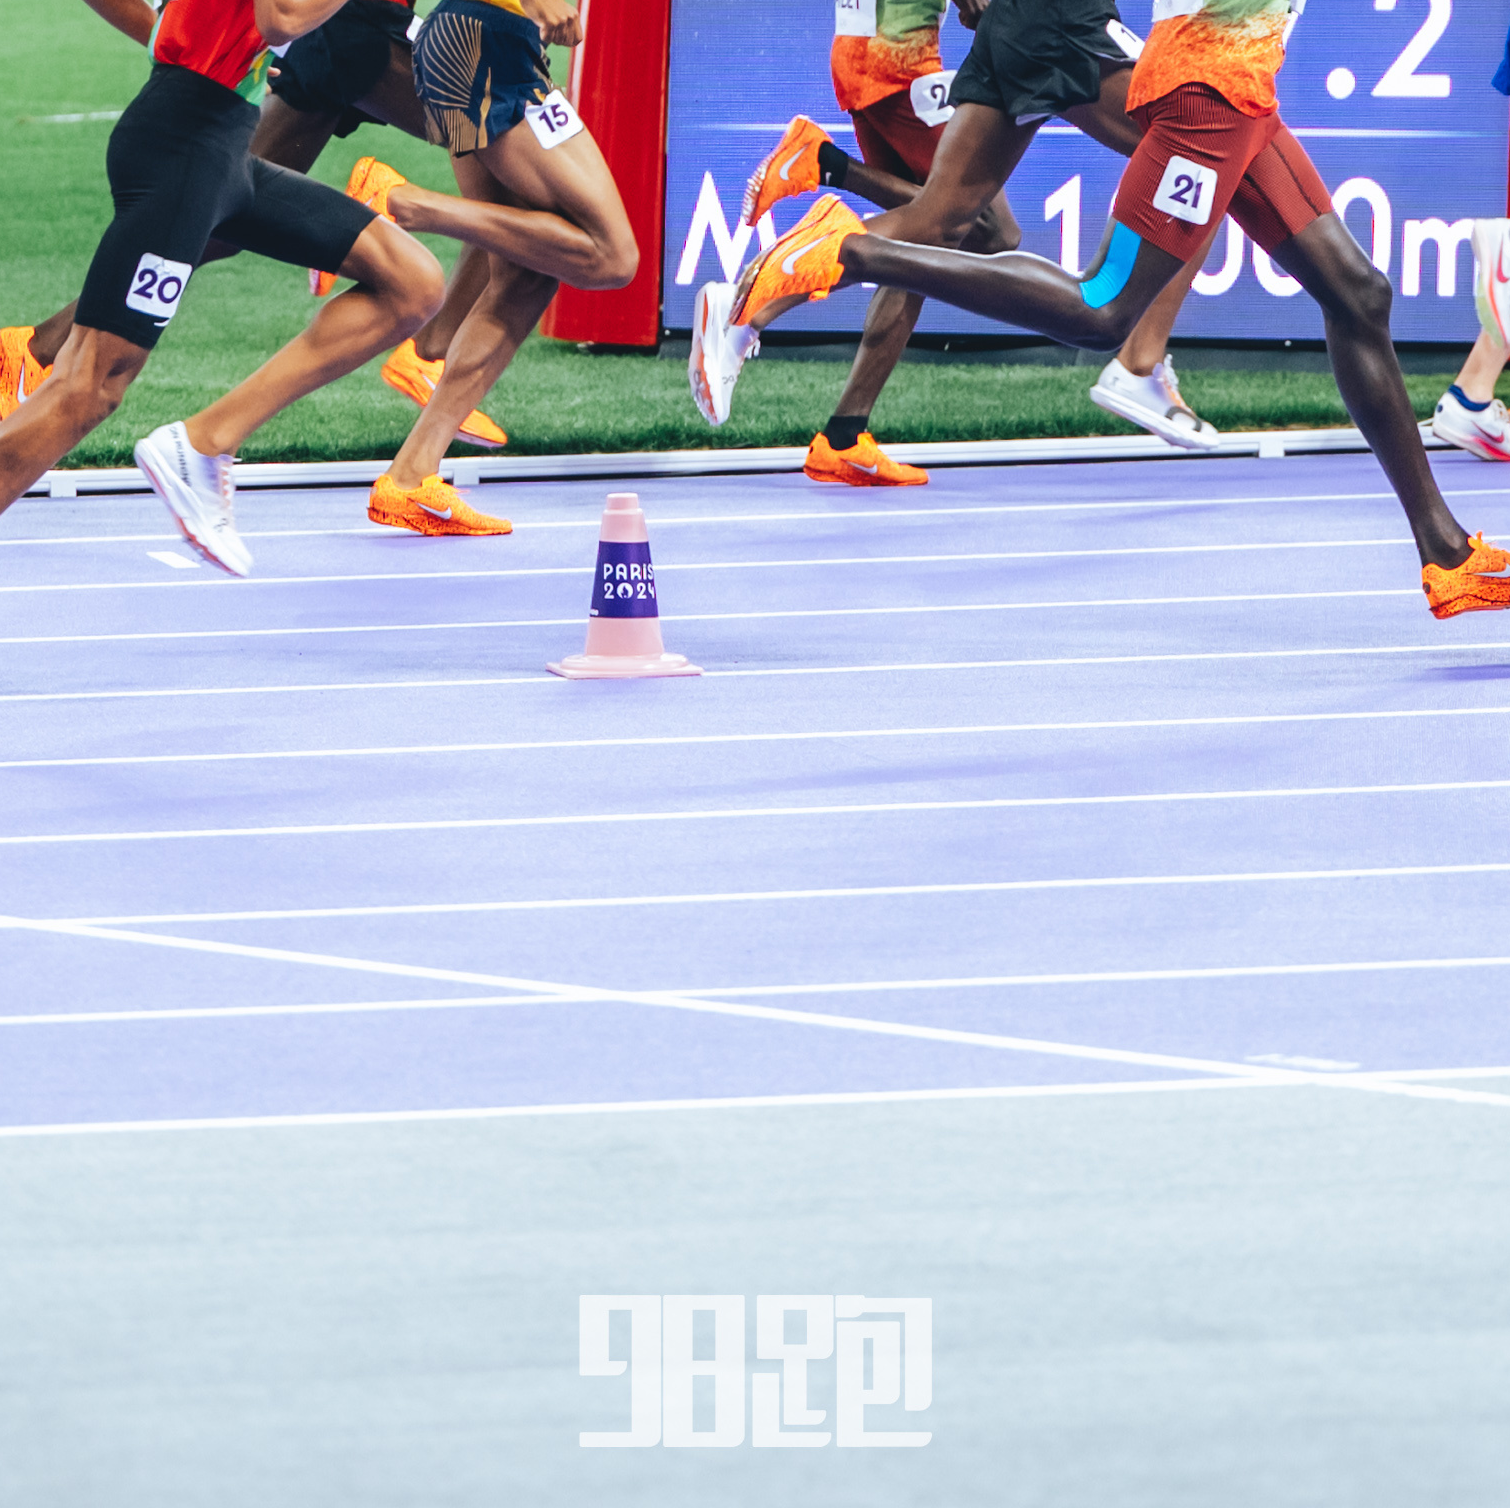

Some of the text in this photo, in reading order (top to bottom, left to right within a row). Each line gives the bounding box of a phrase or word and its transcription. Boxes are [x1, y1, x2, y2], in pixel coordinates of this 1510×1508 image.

[538, 103, 570, 133] 15
[1168, 173, 1204, 209] 21
[133, 268, 182, 304] 20
[603, 563, 654, 580] PARIS
[604, 582, 656, 600] 2024
